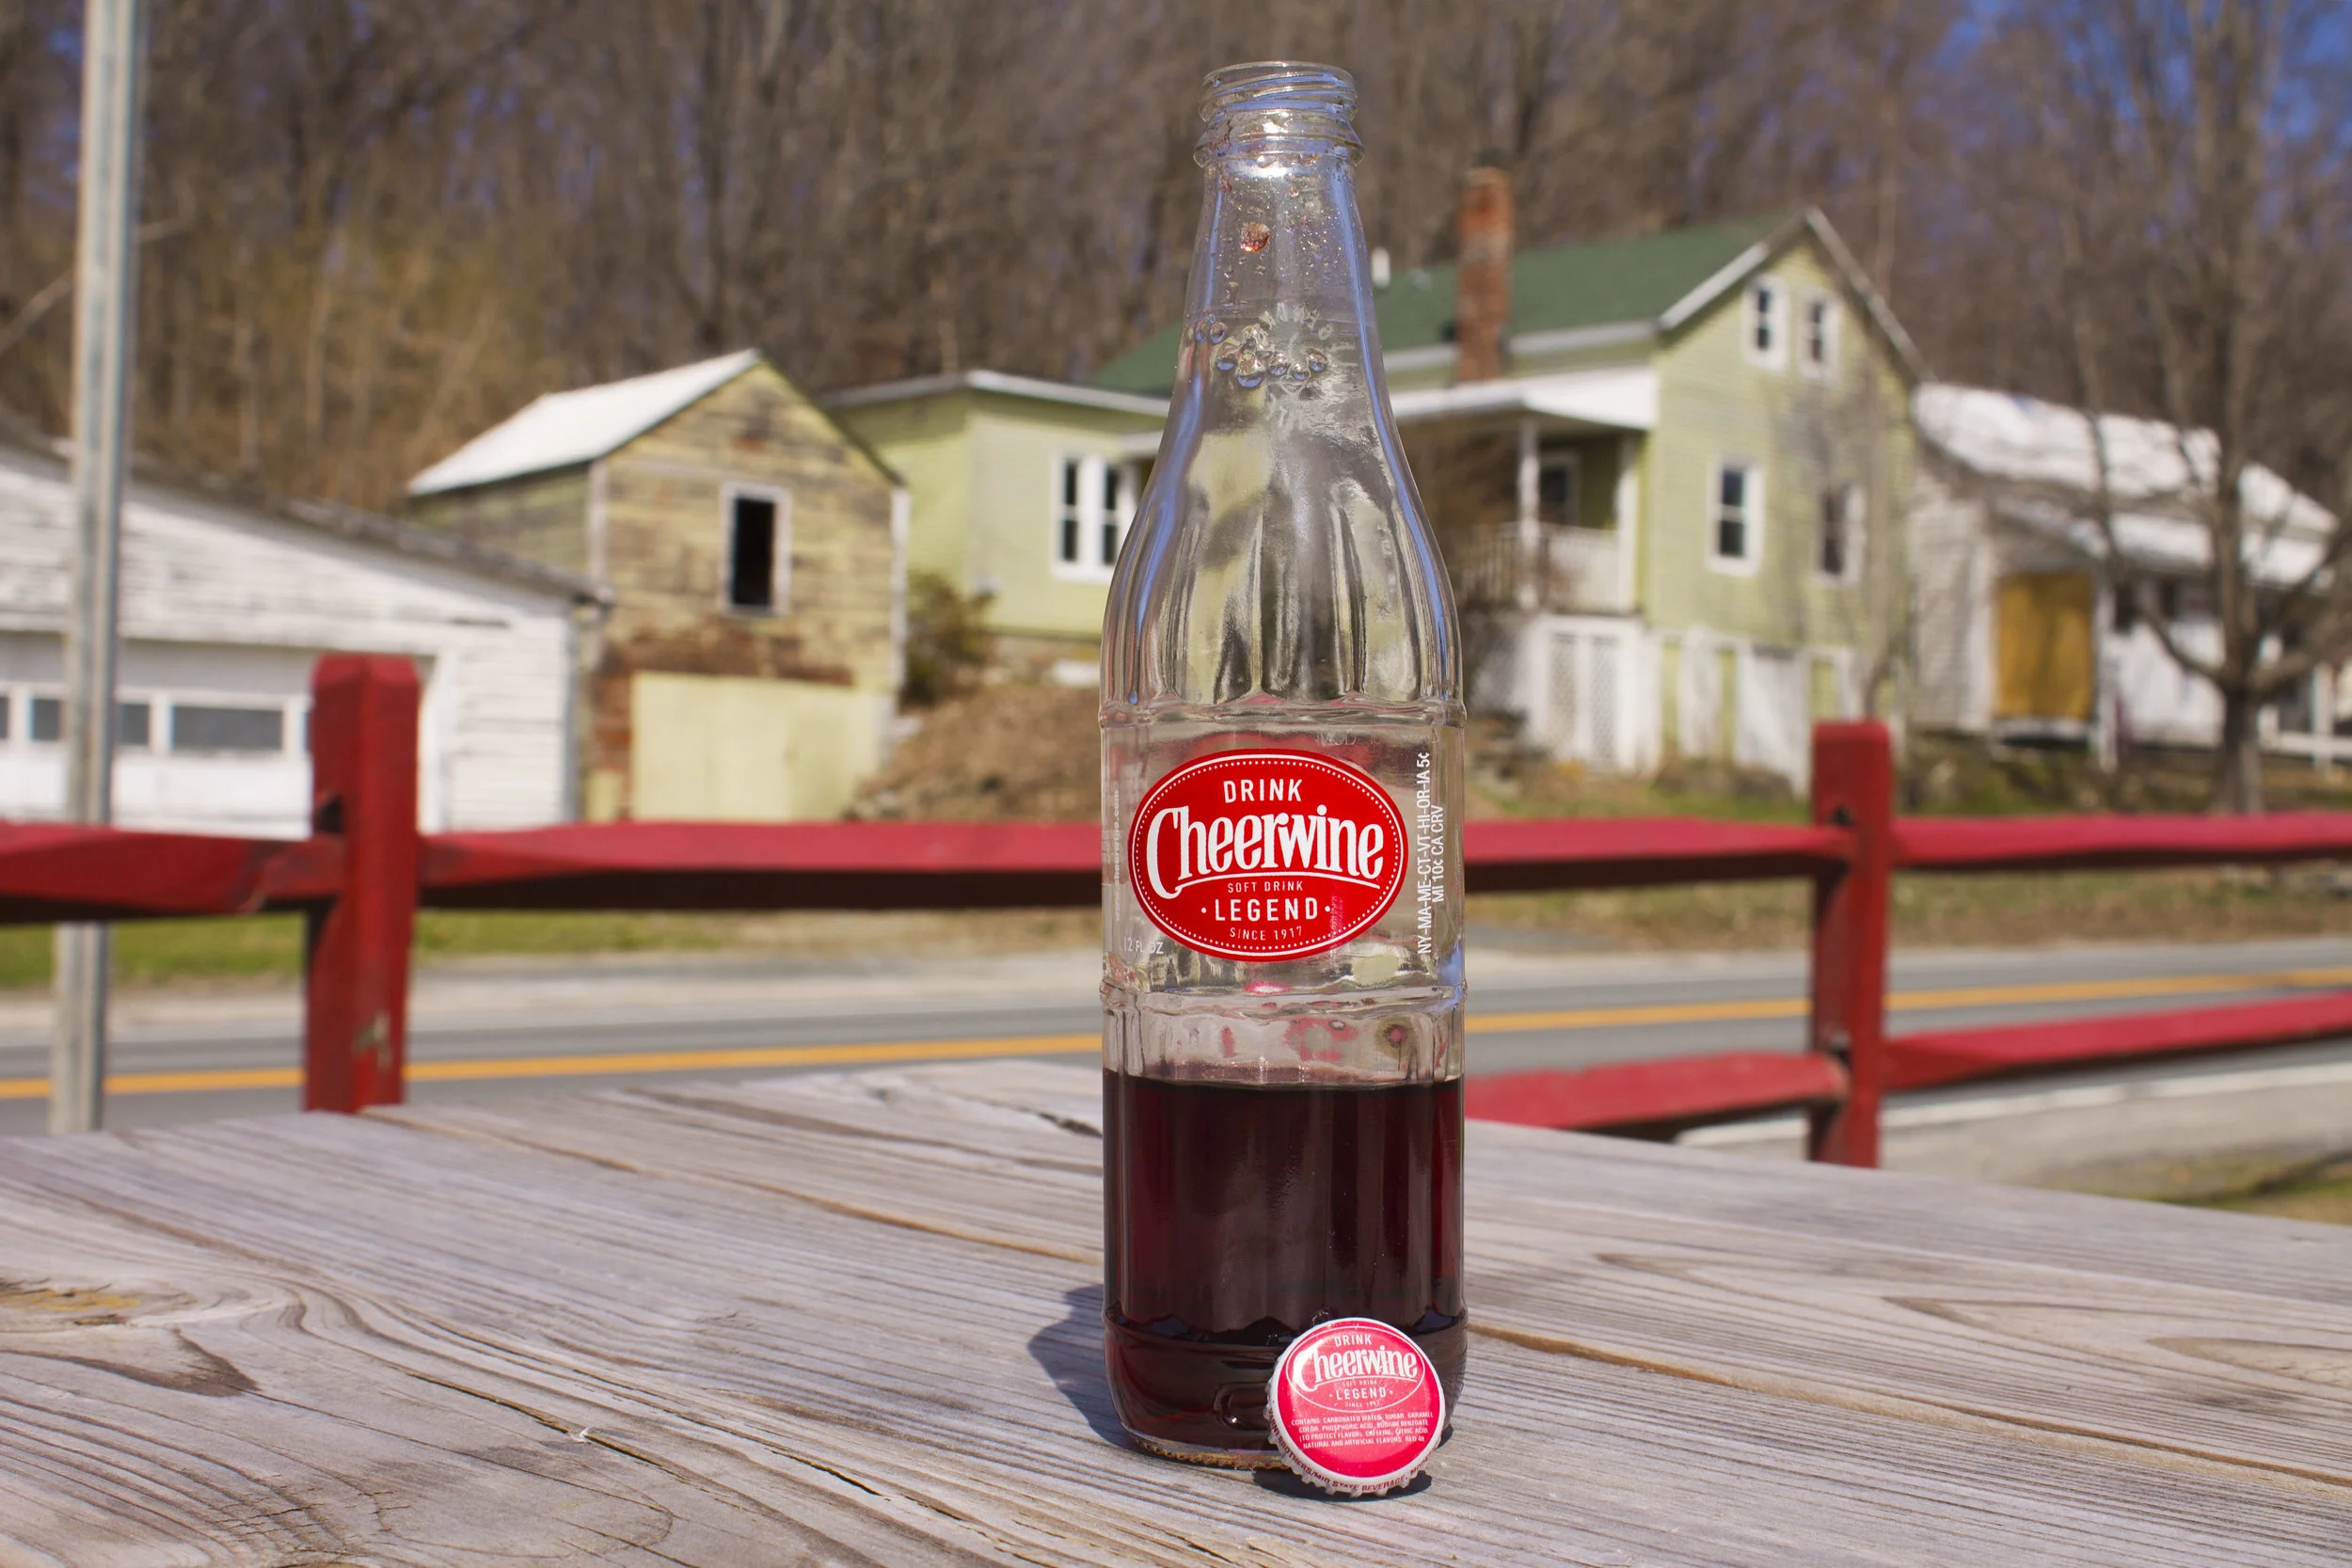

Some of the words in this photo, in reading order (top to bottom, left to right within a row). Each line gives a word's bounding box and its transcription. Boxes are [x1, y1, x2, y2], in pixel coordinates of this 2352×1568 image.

[1417, 752, 1431, 768] 5¢
[1223, 779, 1303, 803] DRINK
[1431, 804, 1444, 833] CRV
[1147, 804, 1384, 899] Cheerwine
[1431, 835, 1444, 856] CA
[1431, 859, 1444, 882] 10¢
[1227, 881, 1260, 894] SOFT
[1263, 879, 1304, 893] DRINK
[1431, 885, 1444, 903] MI
[1215, 896, 1318, 922] LEGEND
[1230, 927, 1267, 941] SINCE
[1273, 926, 1303, 941] 1917
[1123, 937, 1133, 952] 12
[1148, 941, 1165, 955] OZ
[1334, 1334, 1373, 1347] DRINK
[1293, 1339, 1418, 1392] Cheerwine
[1336, 1386, 1387, 1401] LEGEND
